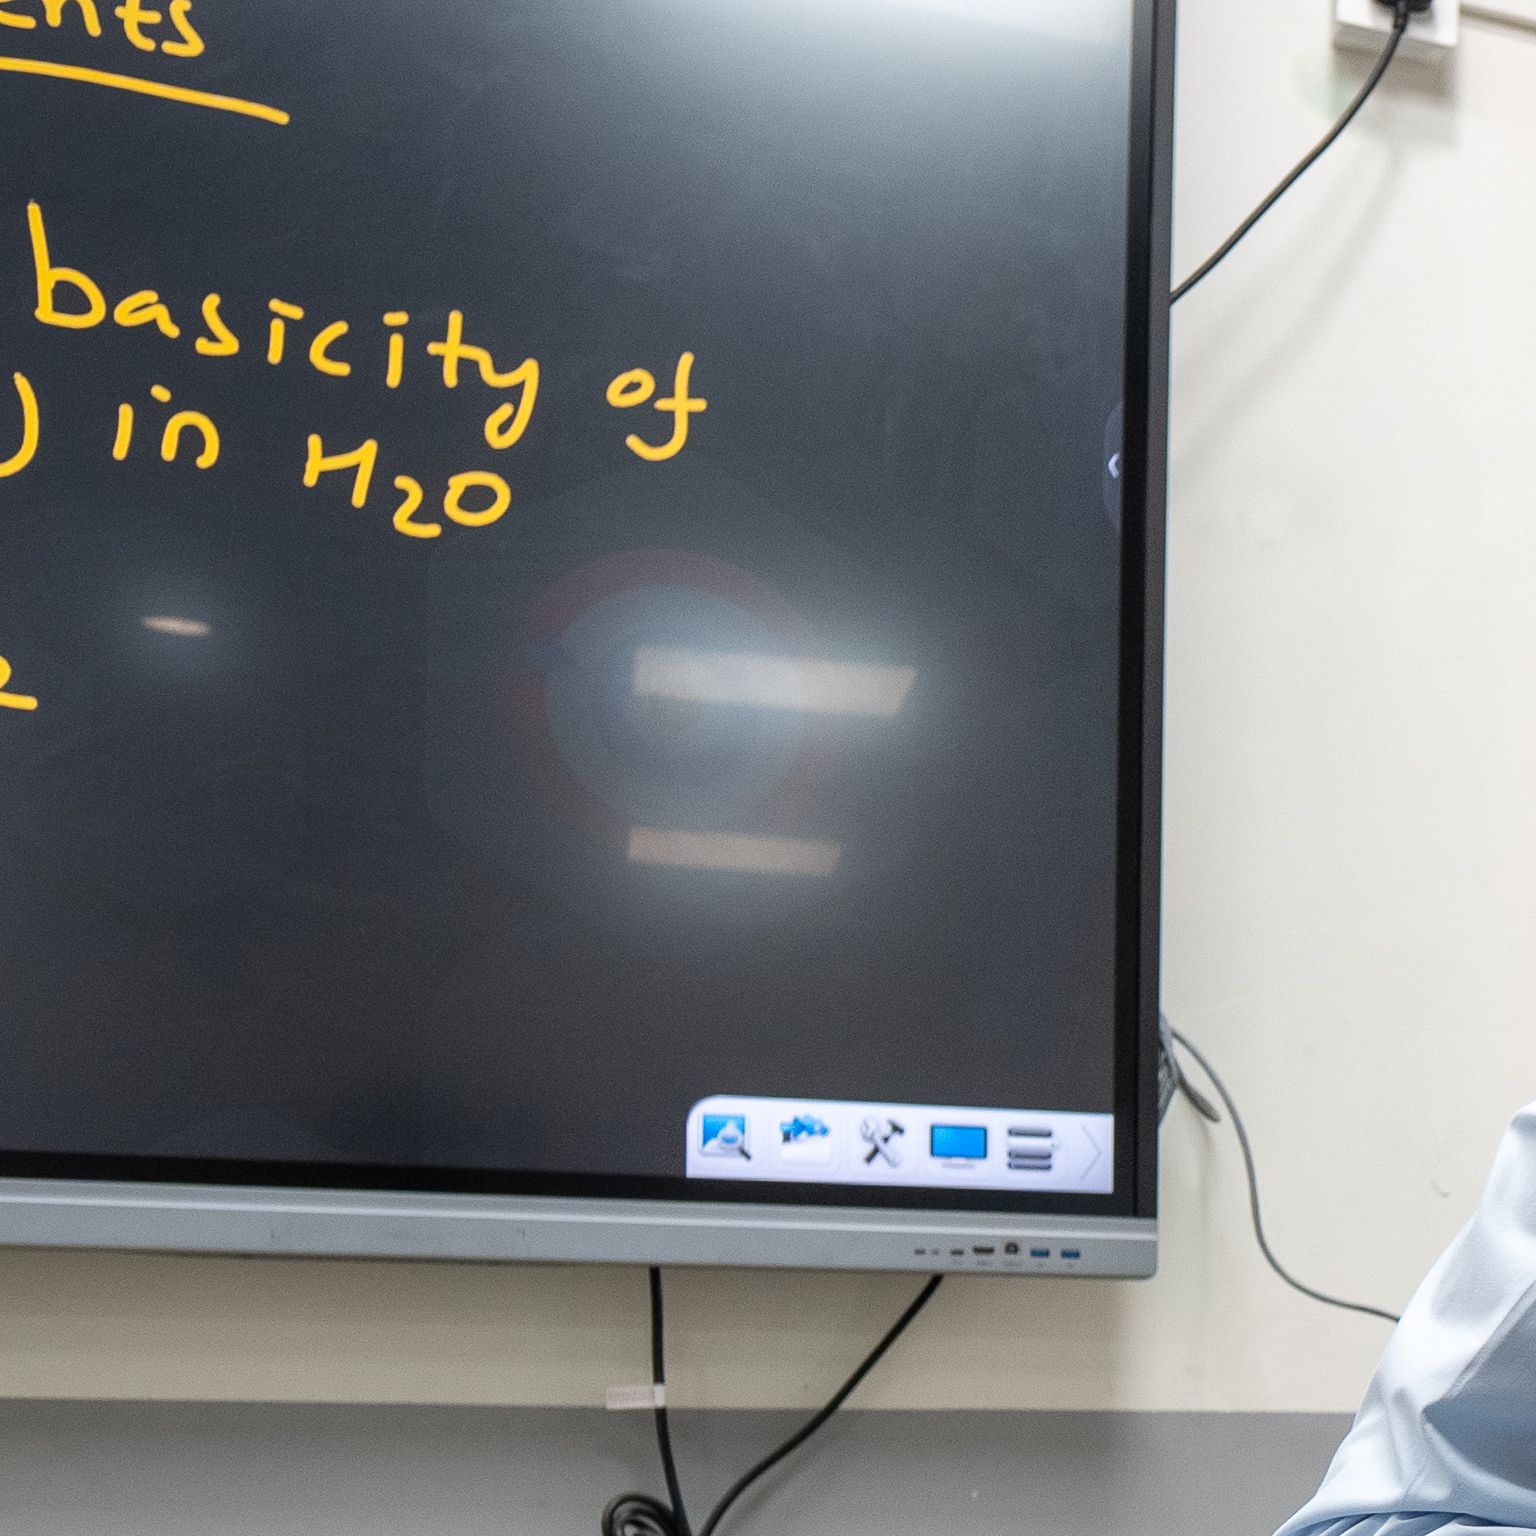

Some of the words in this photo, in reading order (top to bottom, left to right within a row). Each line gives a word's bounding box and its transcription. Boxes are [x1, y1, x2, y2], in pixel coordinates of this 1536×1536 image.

[27, 202, 539, 449] basicity
[607, 352, 707, 461] of
[113, 384, 220, 469] in
